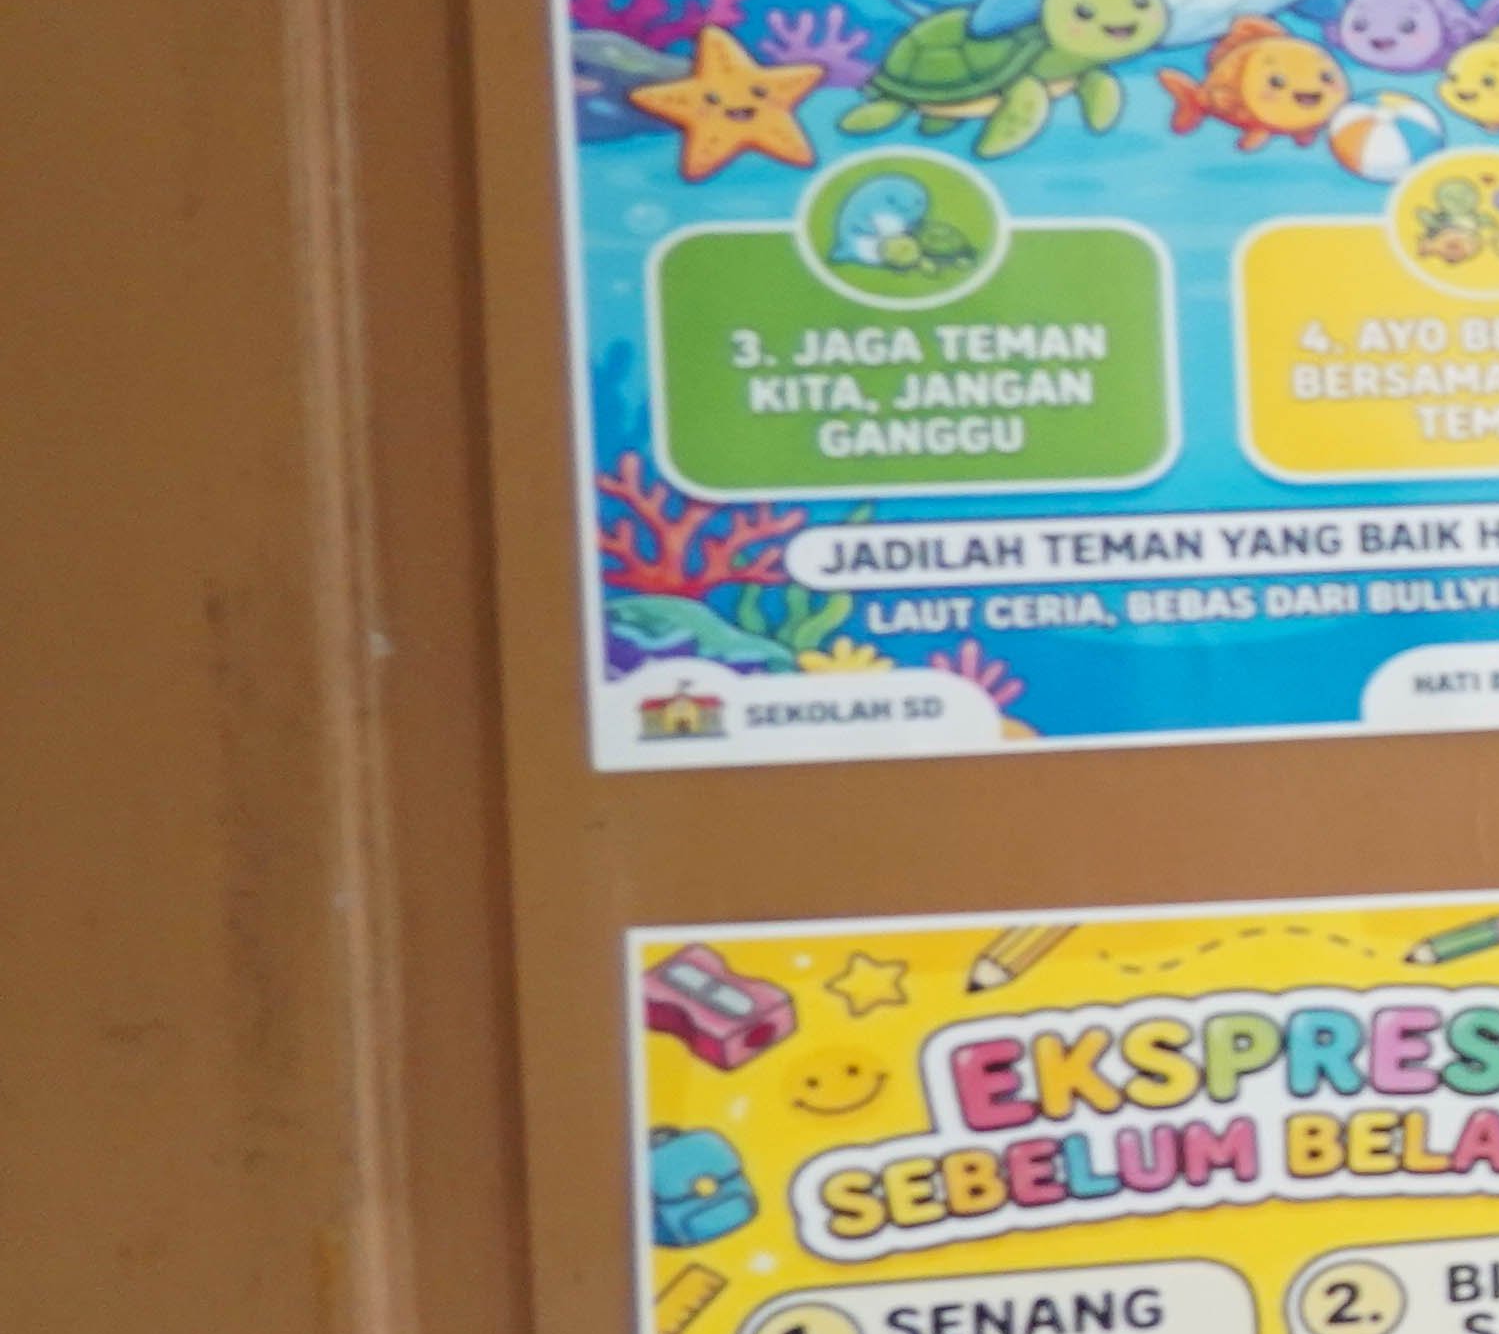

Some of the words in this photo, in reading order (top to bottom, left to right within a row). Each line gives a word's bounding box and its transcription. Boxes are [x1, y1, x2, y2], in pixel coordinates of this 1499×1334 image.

[730, 328, 777, 367] 3.
[793, 325, 923, 366] JAGA
[936, 324, 1107, 362] TEMAN
[1301, 320, 1344, 354] 4.
[1358, 317, 1447, 354] AYO
[748, 374, 879, 413] KITA,
[893, 369, 1092, 409] JANGAN
[818, 417, 1025, 458] GANGGU
[823, 535, 1024, 575] JADILAH
[1043, 529, 1201, 567] TEMAN
[1220, 523, 1341, 562] YANG
[1361, 520, 1460, 554] BAIK
[867, 598, 975, 634] LAUT
[985, 594, 1116, 630] CERIA,
[1128, 585, 1254, 623] BEBAS
[1266, 581, 1359, 618] DARI
[1413, 671, 1481, 696] HATI
[746, 699, 891, 728] SEKOLAH
[903, 696, 944, 721] SD
[821, 1119, 1258, 1242] SEBELUM
[1324, 1281, 1382, 1325] 2.
